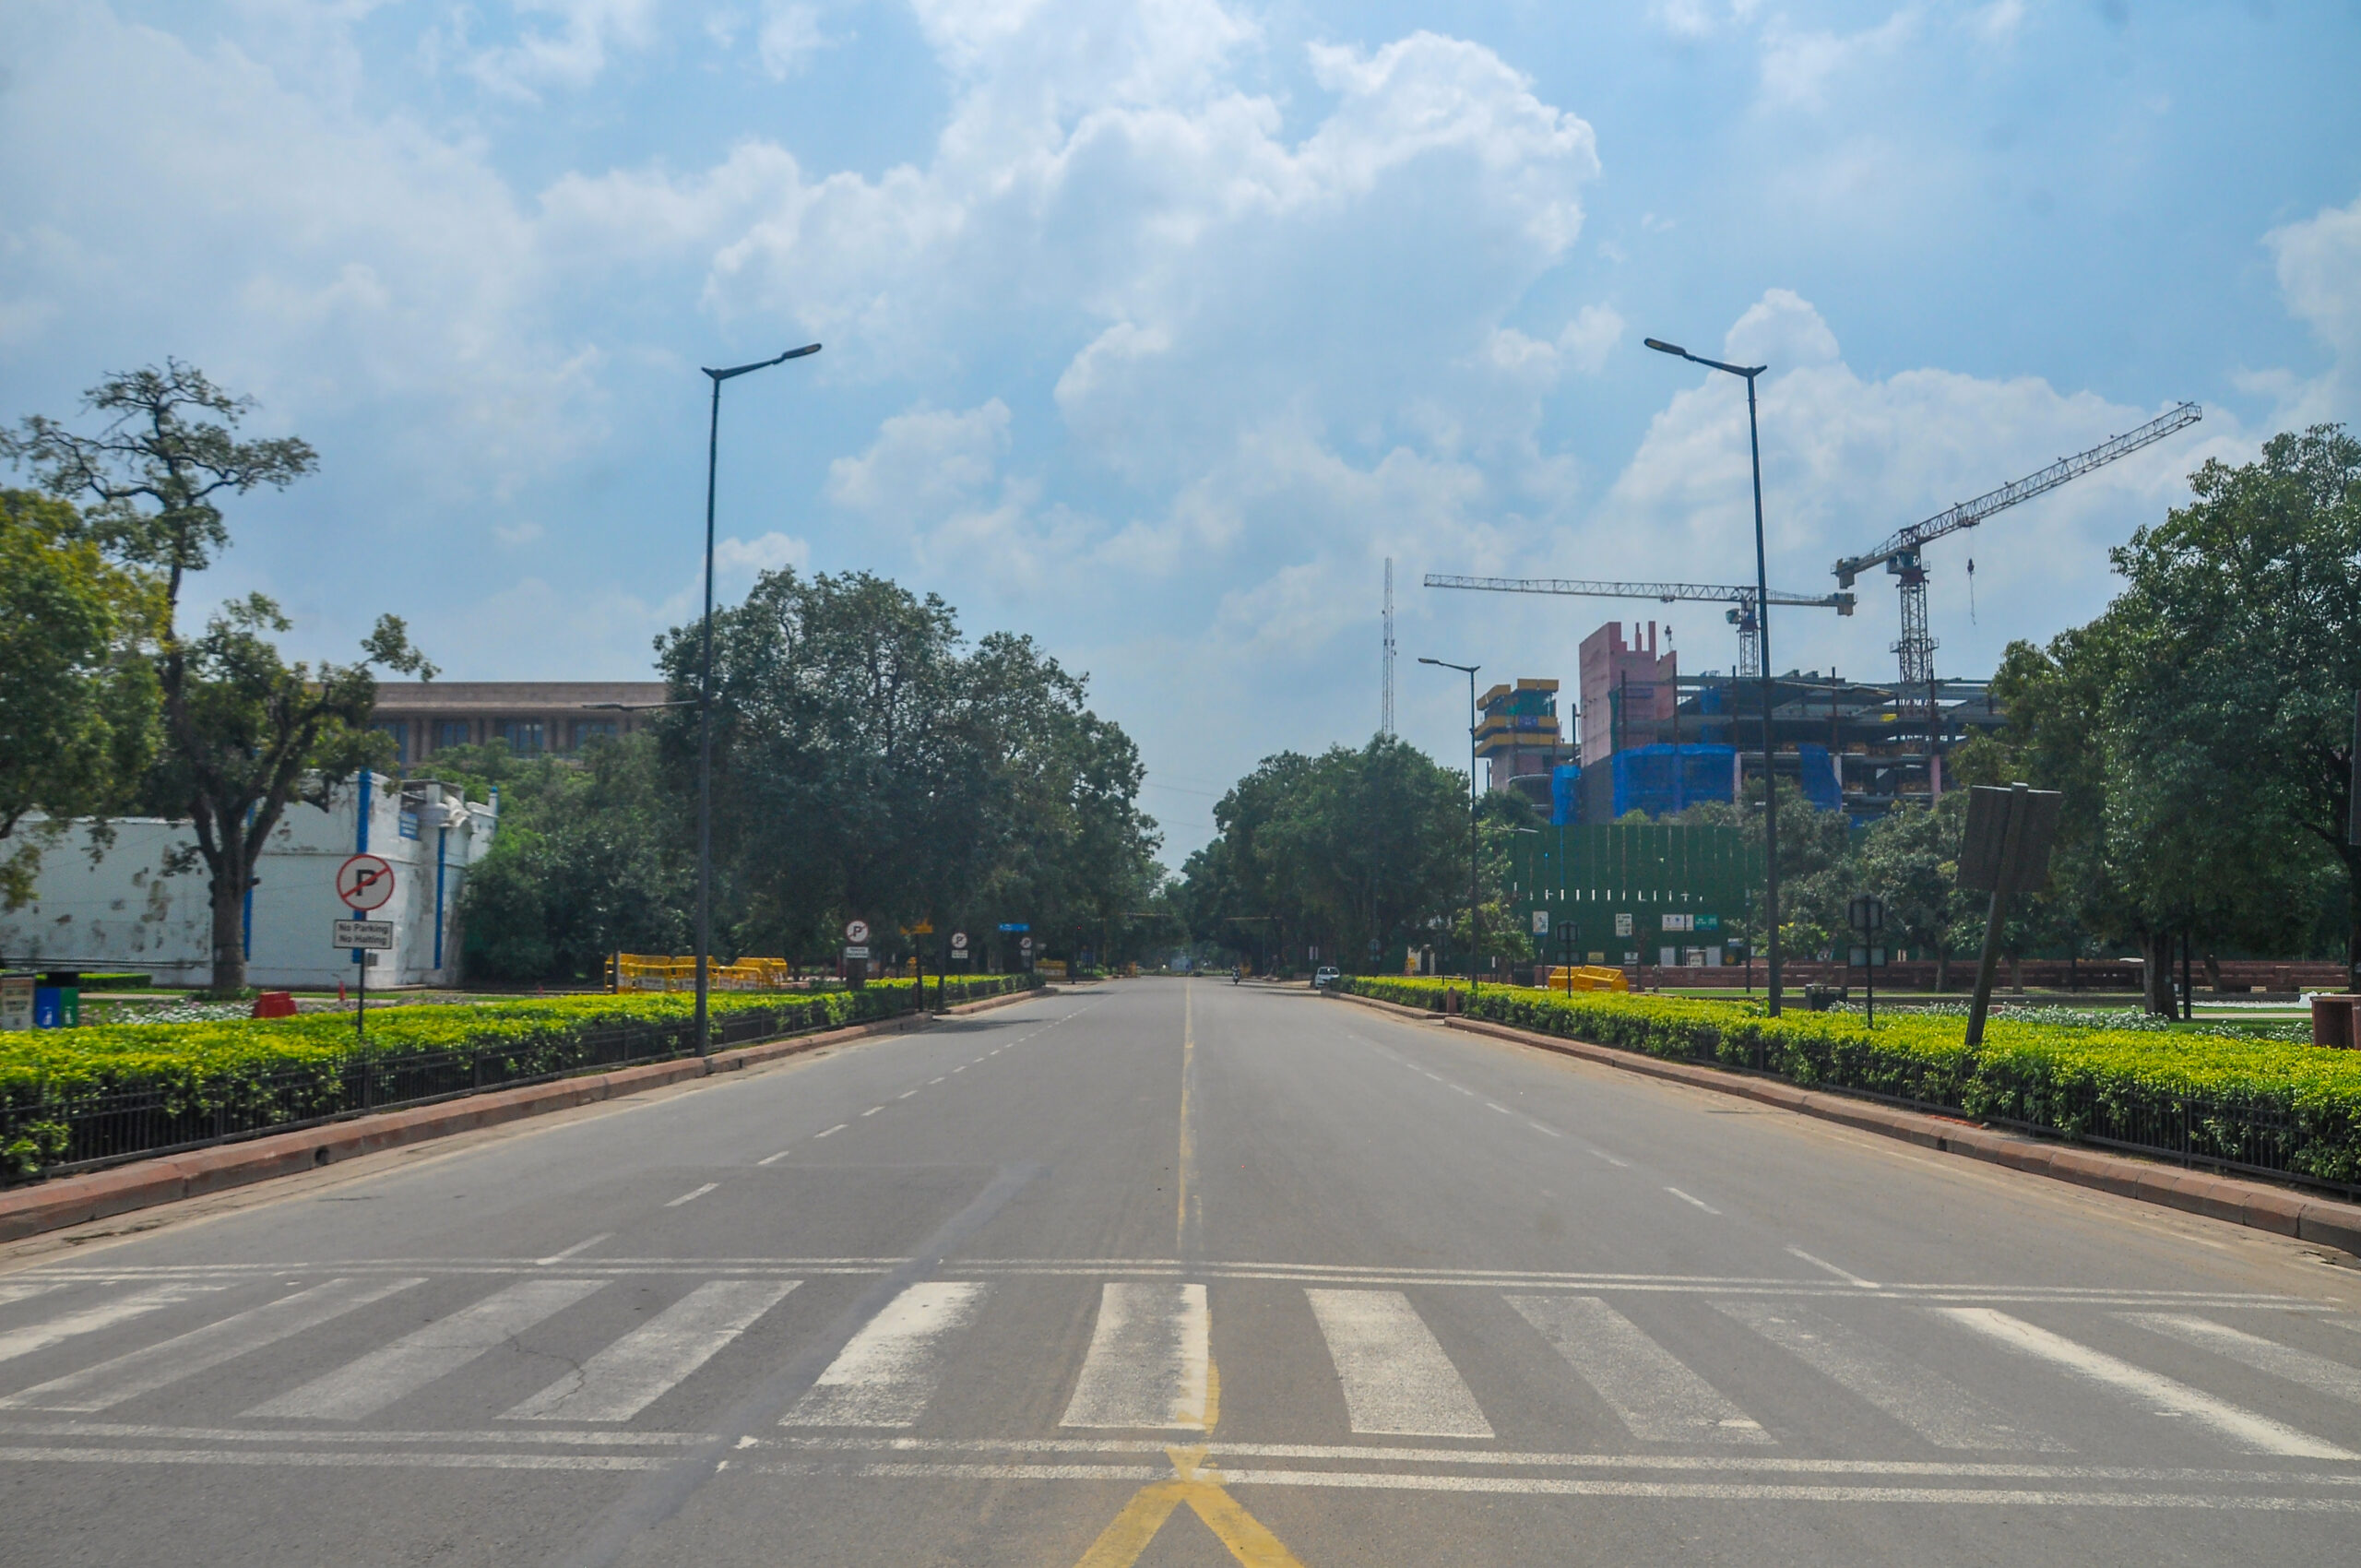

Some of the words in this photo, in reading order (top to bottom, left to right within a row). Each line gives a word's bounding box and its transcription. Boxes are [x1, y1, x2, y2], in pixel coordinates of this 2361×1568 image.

[356, 869, 377, 897] P
[338, 923, 351, 932] No
[353, 923, 388, 934] Parking
[853, 925, 862, 937] P
[339, 934, 352, 943] No
[355, 935, 387, 945] Halting
